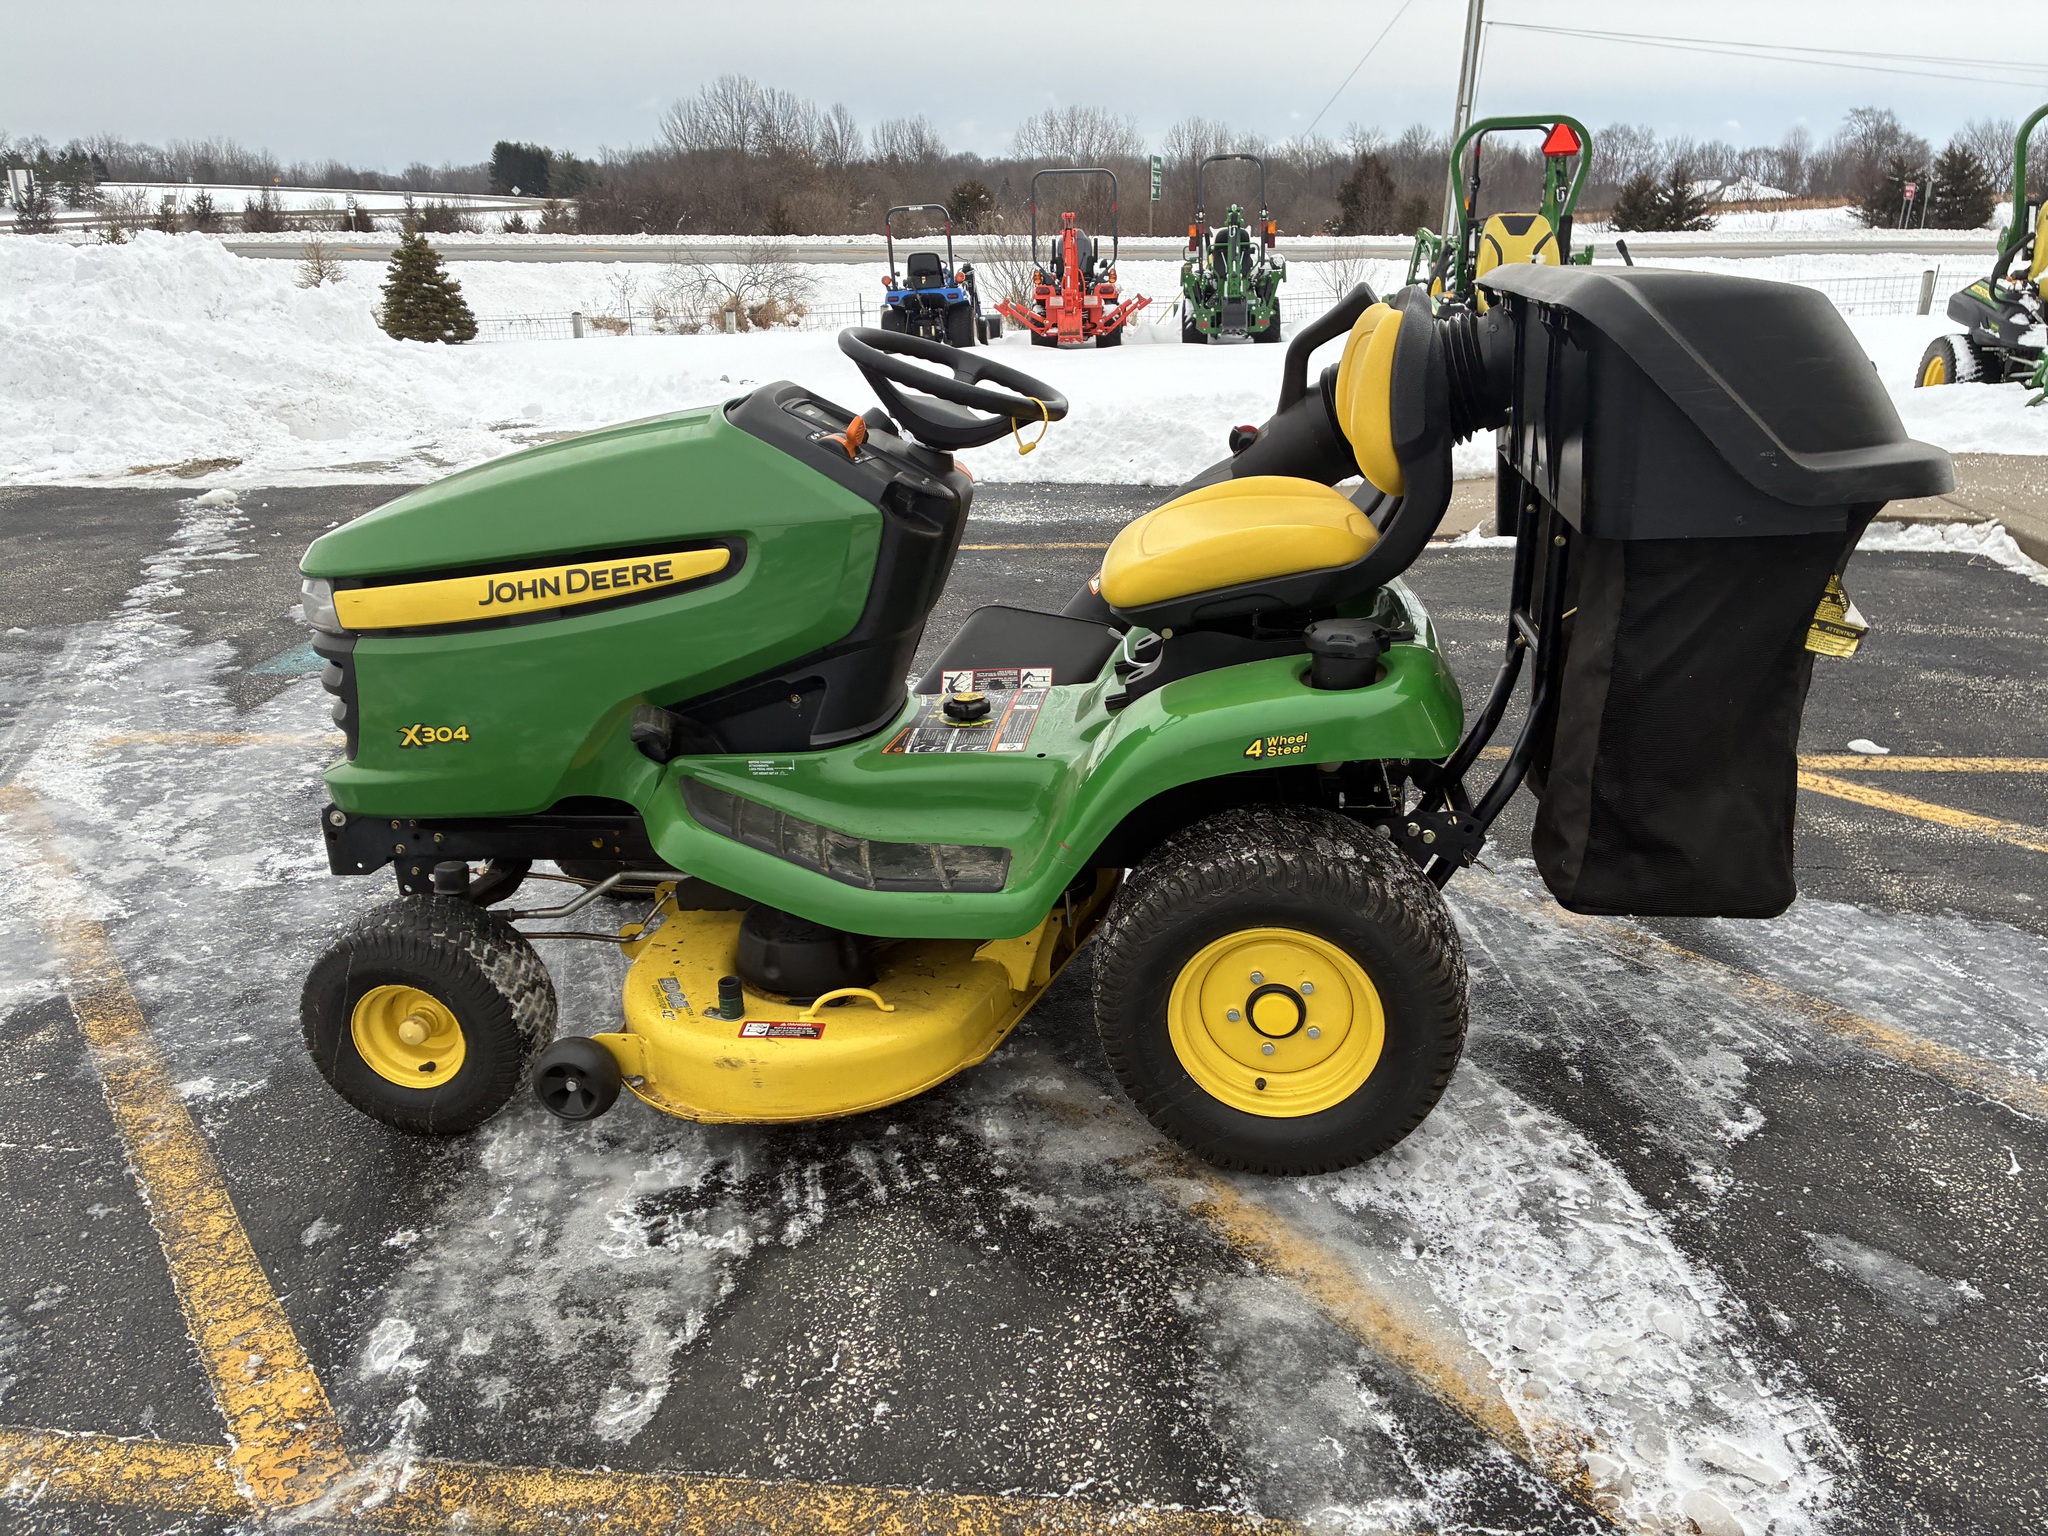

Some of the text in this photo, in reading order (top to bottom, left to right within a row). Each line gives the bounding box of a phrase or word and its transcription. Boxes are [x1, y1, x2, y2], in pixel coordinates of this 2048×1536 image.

[478, 560, 674, 606] JOHN DEERE
[1825, 625, 1857, 638] ATTENTION
[397, 723, 470, 748] X304
[1244, 732, 1308, 759] 4 Wheel
[1266, 744, 1307, 757] Steer
[657, 977, 691, 1010] EDGE
